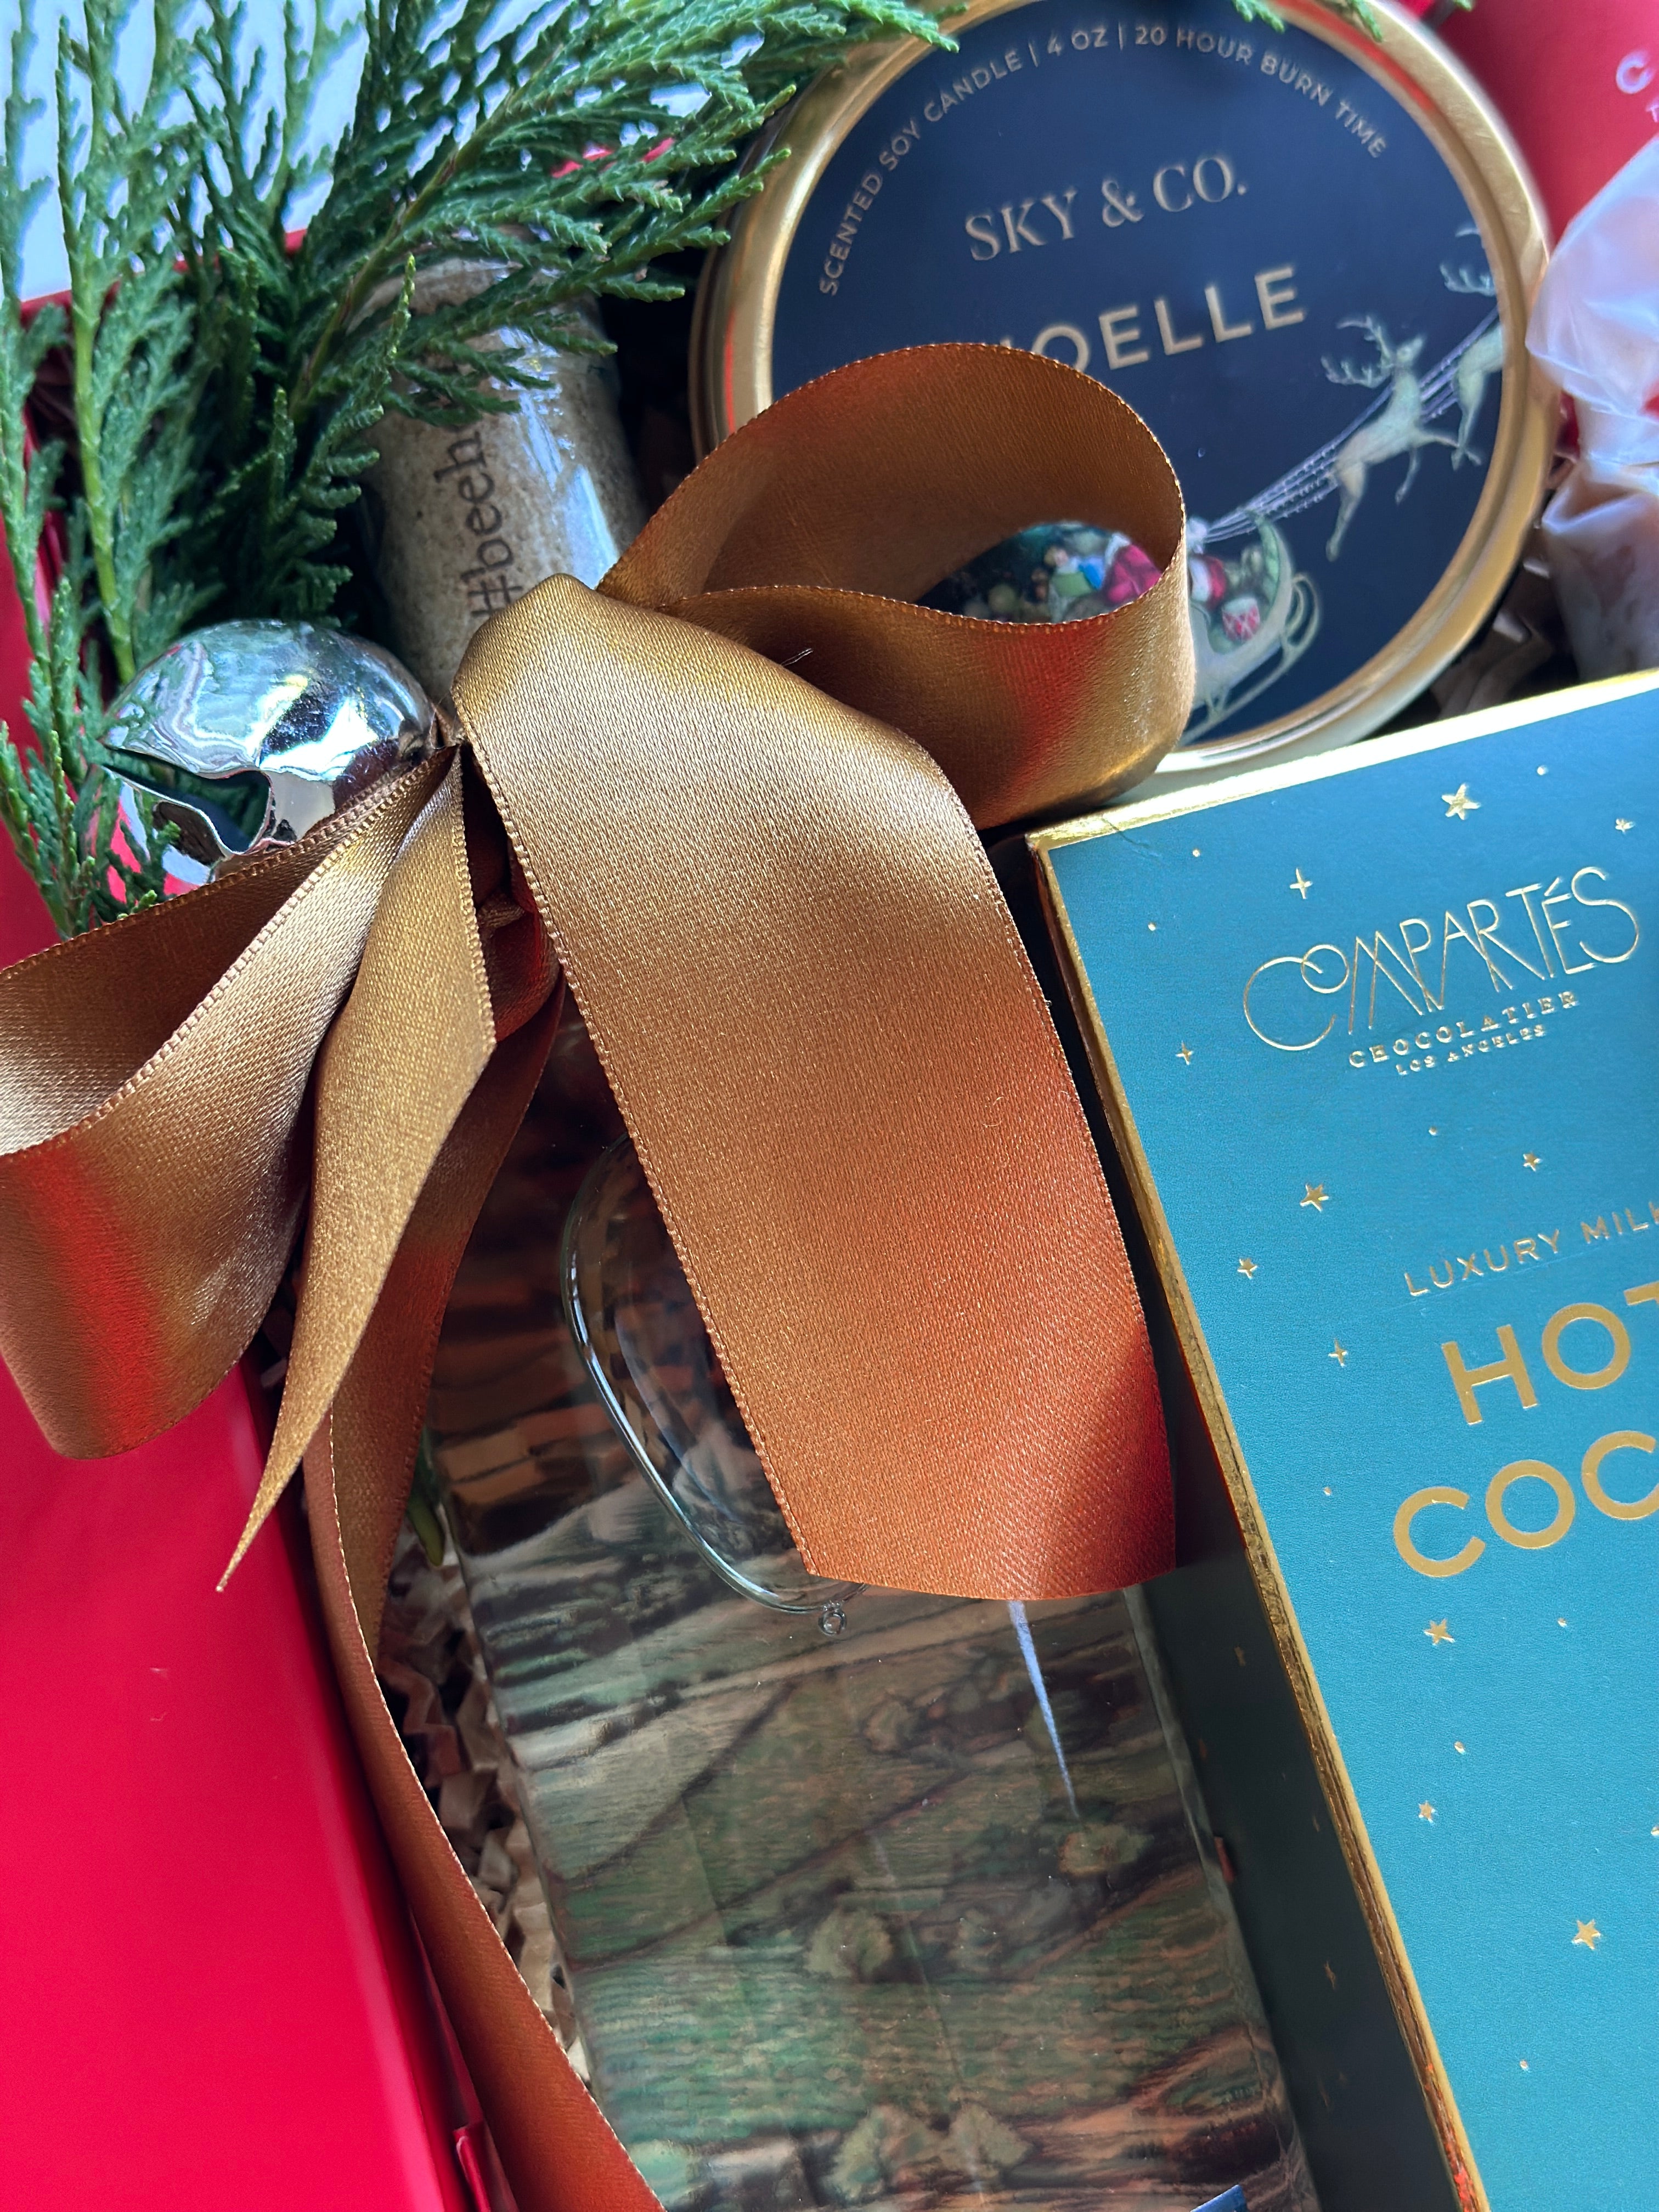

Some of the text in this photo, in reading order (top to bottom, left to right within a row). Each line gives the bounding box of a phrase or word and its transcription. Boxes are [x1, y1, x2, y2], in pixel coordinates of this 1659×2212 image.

[820, 169, 883, 297] SCENTED
[879, 117, 921, 172] SOY
[924, 47, 1023, 122] CANDLE
[1047, 32, 1062, 56] 4
[1071, 25, 1109, 50] OZ
[1135, 26, 1167, 47] 20
[1176, 26, 1254, 65] HOUR
[1260, 52, 1334, 106] BURN
[1335, 100, 1387, 159] TIME
[964, 156, 1247, 261] SKY & CO.
[1000, 263, 1307, 374] OELLE
[1243, 866, 1640, 1052] COMPARTÉS
[1395, 1054, 1438, 1076] LOS
[1403, 1228, 1560, 1297] LUXURY
